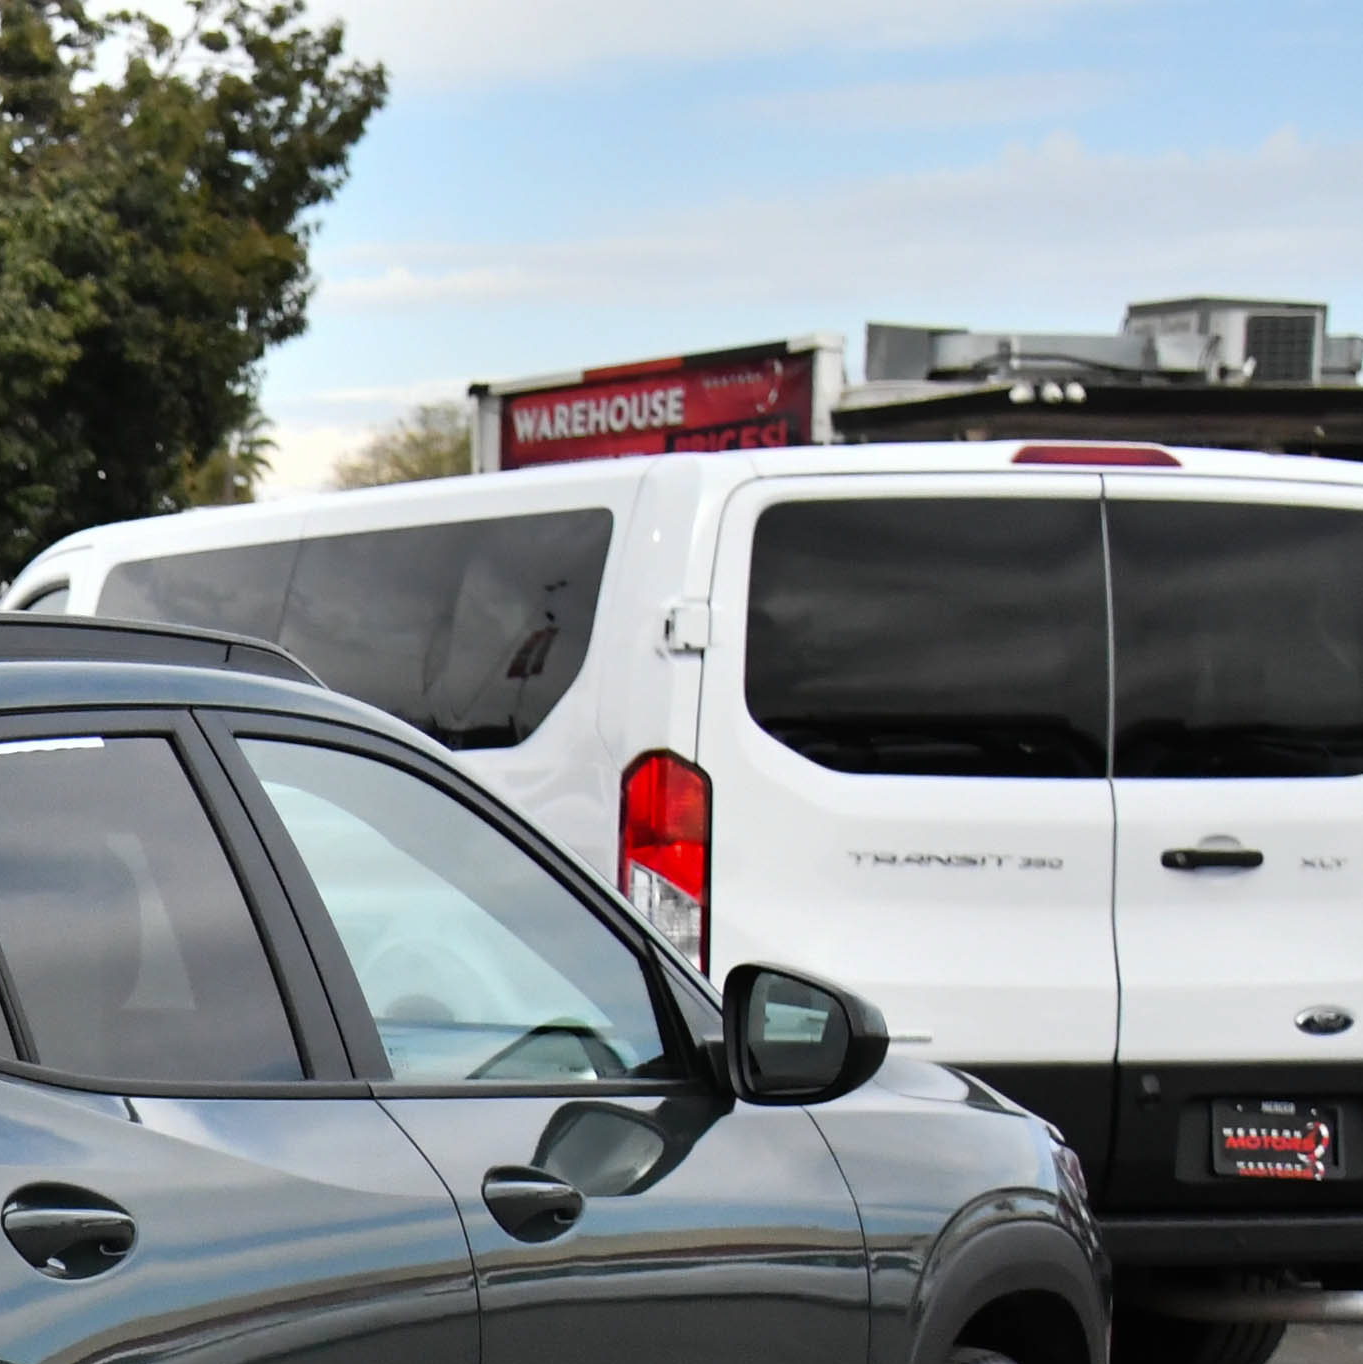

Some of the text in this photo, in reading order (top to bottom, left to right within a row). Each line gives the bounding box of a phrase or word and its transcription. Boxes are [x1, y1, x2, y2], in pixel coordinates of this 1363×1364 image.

[512, 386, 687, 444] WAREHOUSE
[848, 849, 1012, 868] TRANSIT
[1225, 1135, 1317, 1153] MOTORS
